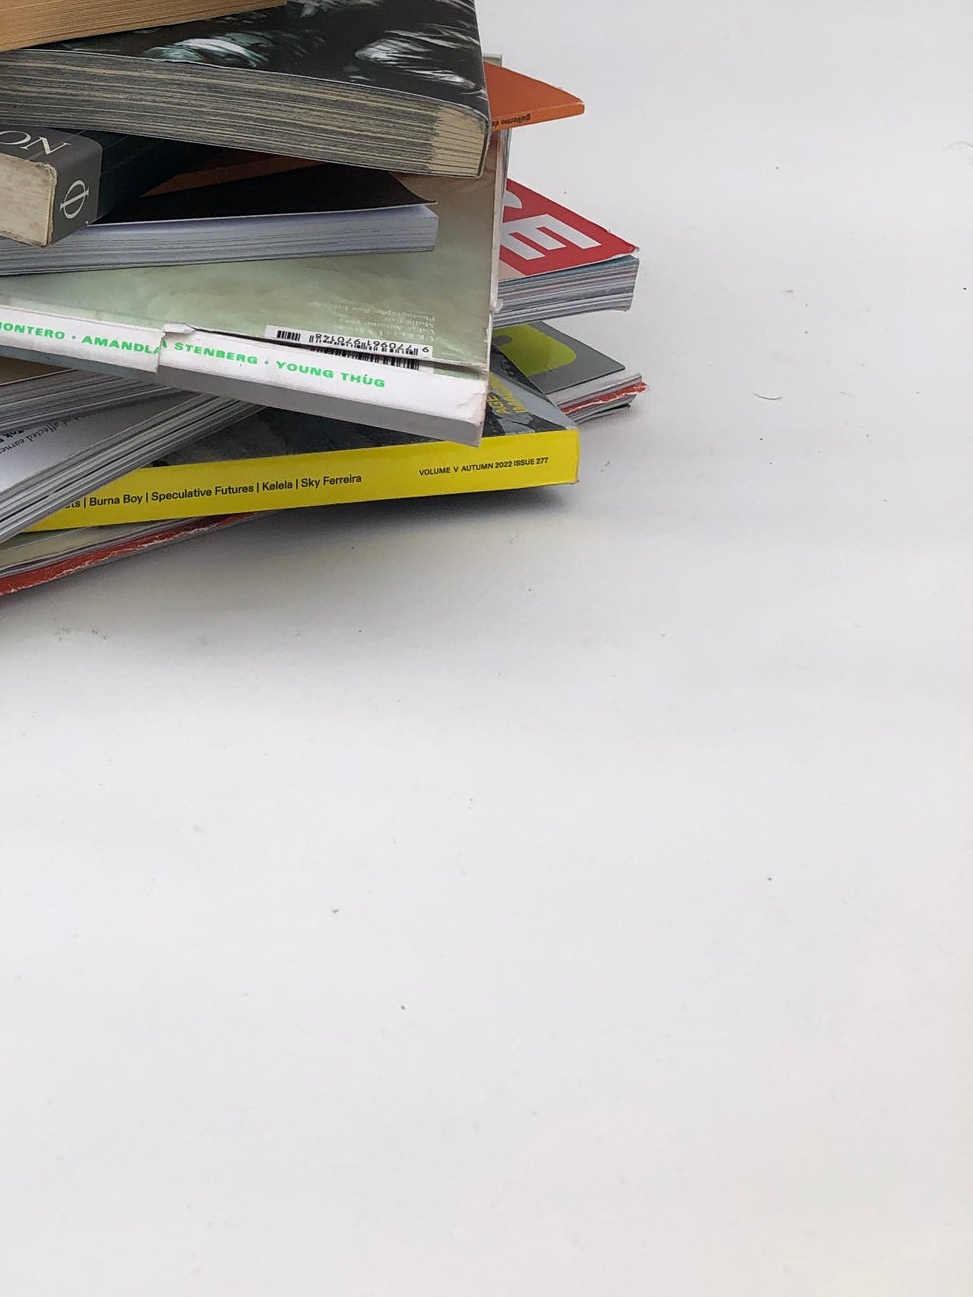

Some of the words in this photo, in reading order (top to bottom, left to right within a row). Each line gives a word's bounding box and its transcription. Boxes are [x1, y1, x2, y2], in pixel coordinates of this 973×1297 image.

[174, 342, 259, 366] STENBERG
[275, 360, 335, 379] YOUNG
[419, 466, 451, 476] VOLUME
[461, 462, 494, 472] AUTUMN
[495, 460, 512, 469] 2022
[513, 459, 535, 467] ISSUE
[535, 457, 549, 465] 277
[89, 495, 121, 507] Burna
[122, 492, 143, 507] Boy
[151, 487, 212, 503] Speculative
[214, 482, 254, 496] Futures
[262, 479, 293, 492] Kelela
[301, 475, 320, 490] Sky
[323, 473, 362, 486] Ferreira
